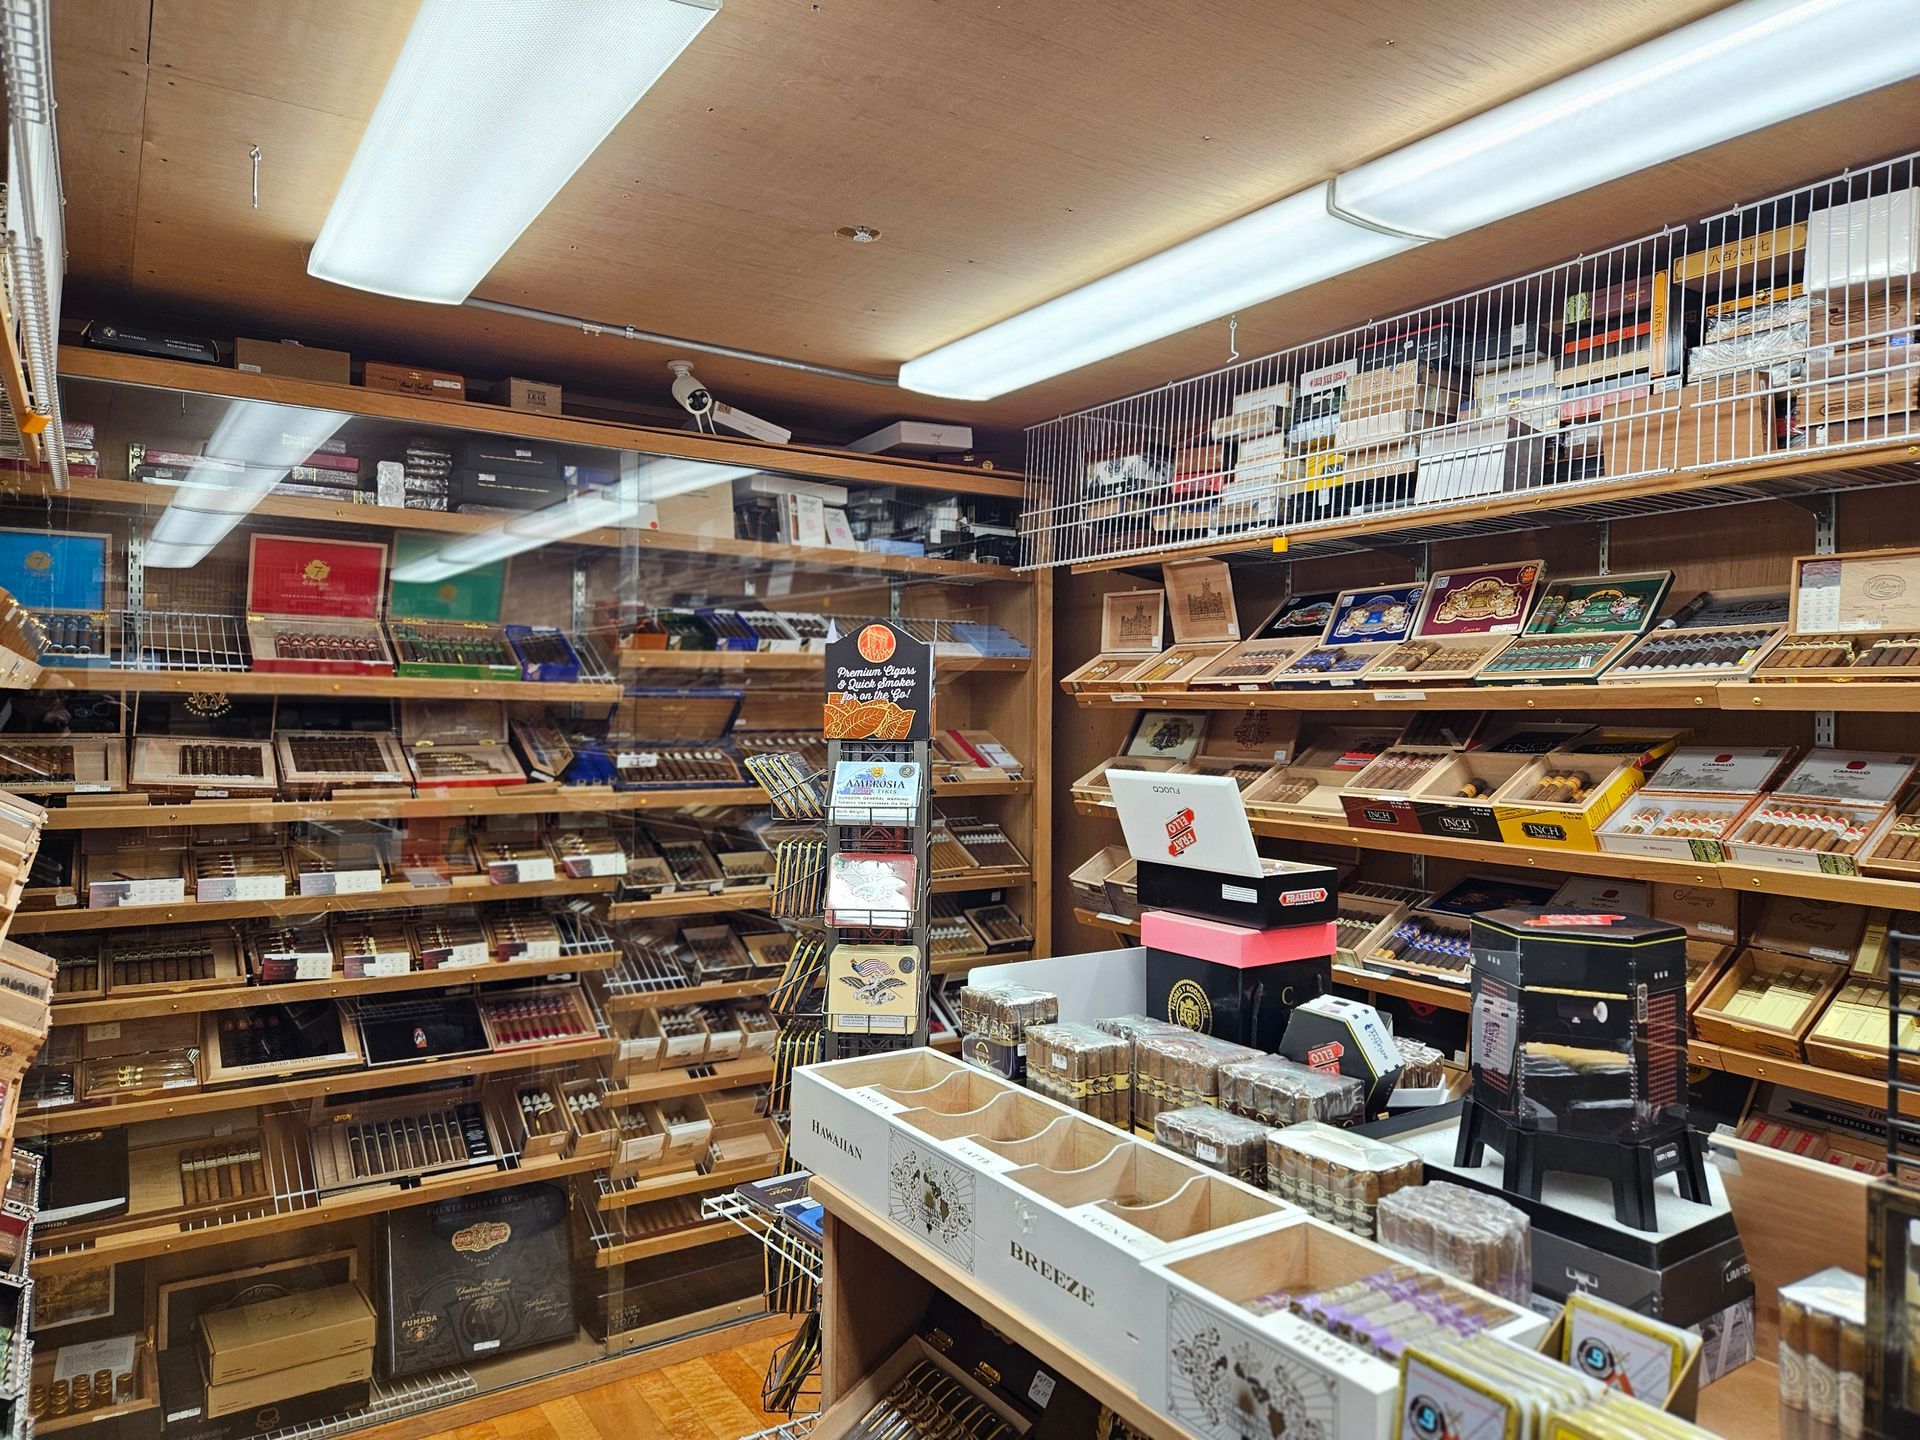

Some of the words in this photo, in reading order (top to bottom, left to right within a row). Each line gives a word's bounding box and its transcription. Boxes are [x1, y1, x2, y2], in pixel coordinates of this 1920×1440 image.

[837, 666, 882, 678] Premium
[883, 664, 917, 678] Cigars
[837, 679, 847, 689] &
[847, 678, 876, 692] Quick
[877, 676, 916, 690] Smokes
[840, 691, 858, 704] for
[873, 690, 889, 700] the
[891, 689, 911, 702] Go!
[845, 779, 905, 789] AMBROSIA
[1152, 785, 1181, 794] FUOCO
[1367, 810, 1390, 820] INCH
[1442, 818, 1472, 829] INCH
[1529, 825, 1560, 836] INCH
[1174, 831, 1195, 852] FRAT
[1285, 890, 1323, 903] FRATELLO
[1171, 987, 1183, 1010] FLORES
[1186, 985, 1209, 1019] RODRIGUEZ
[812, 1119, 863, 1161] HAWAIIAN
[34, 1220, 69, 1231] COHIBA
[1009, 1240, 1095, 1307] BREEZE
[401, 1314, 438, 1328] FUMADA
